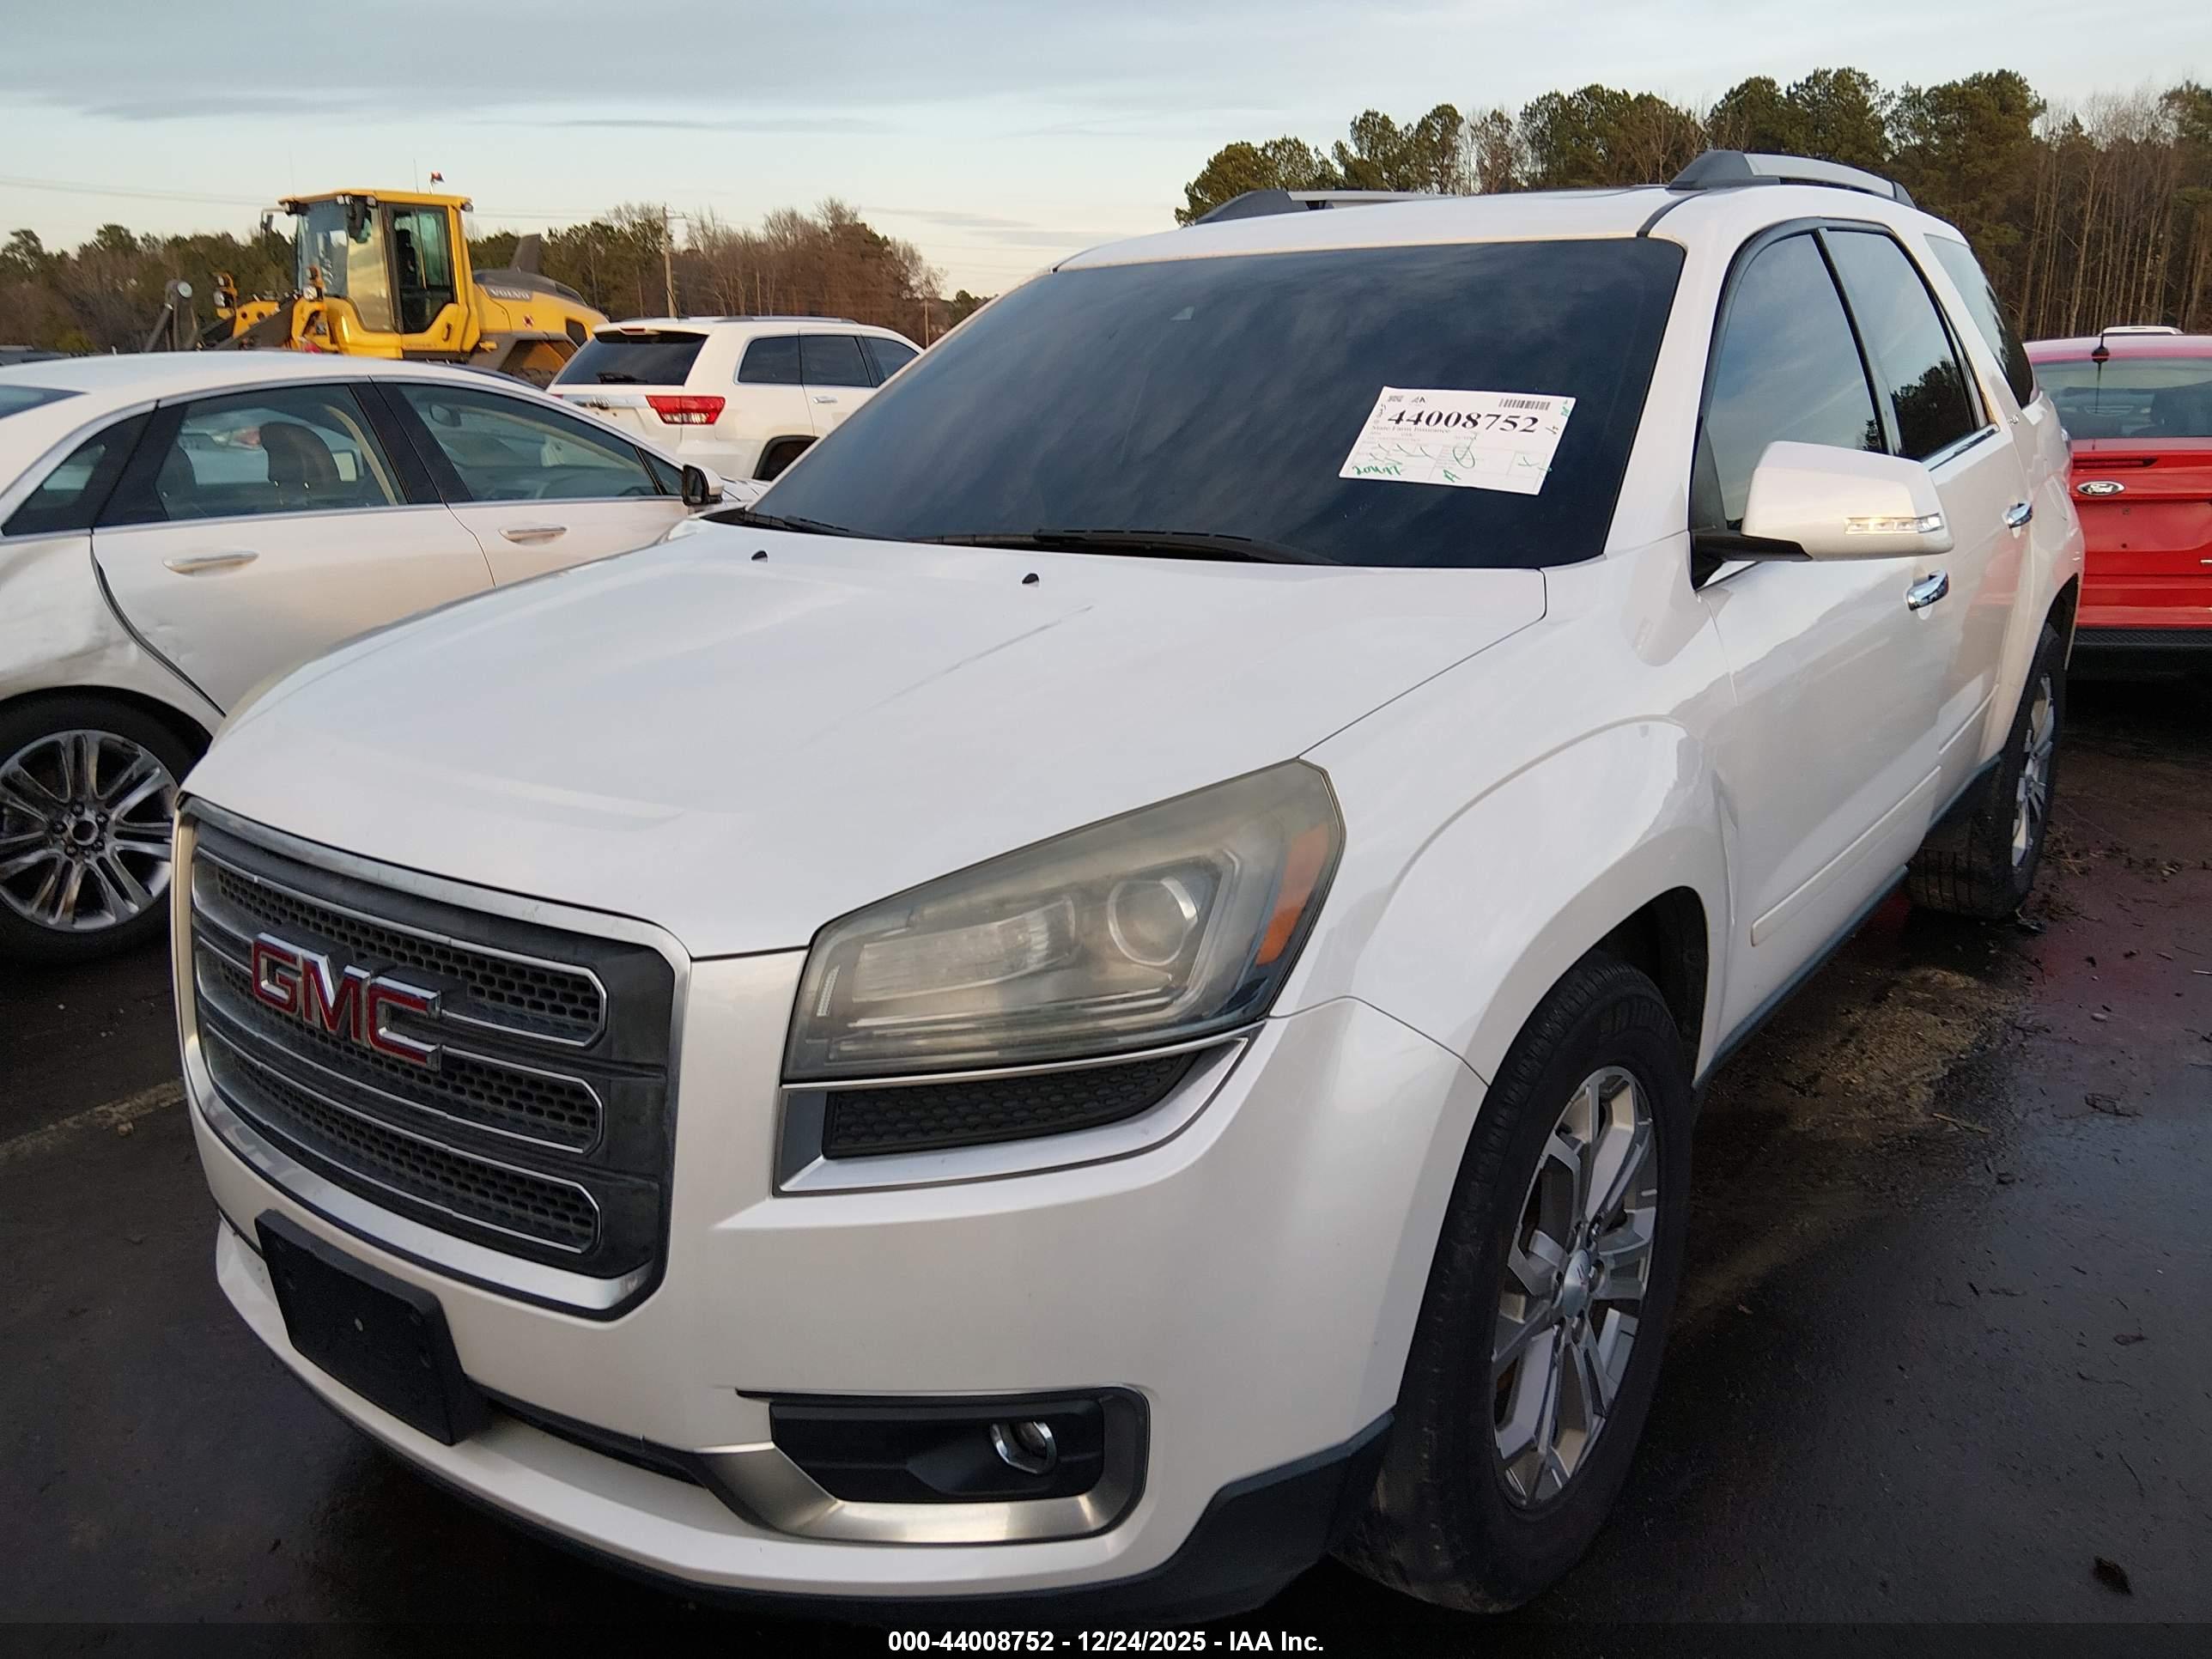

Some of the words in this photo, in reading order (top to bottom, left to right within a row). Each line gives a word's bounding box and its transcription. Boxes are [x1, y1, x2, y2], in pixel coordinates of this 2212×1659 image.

[489, 289, 530, 300] VOLVO
[1388, 409, 1539, 434] 44008752
[252, 932, 441, 1070] GMC
